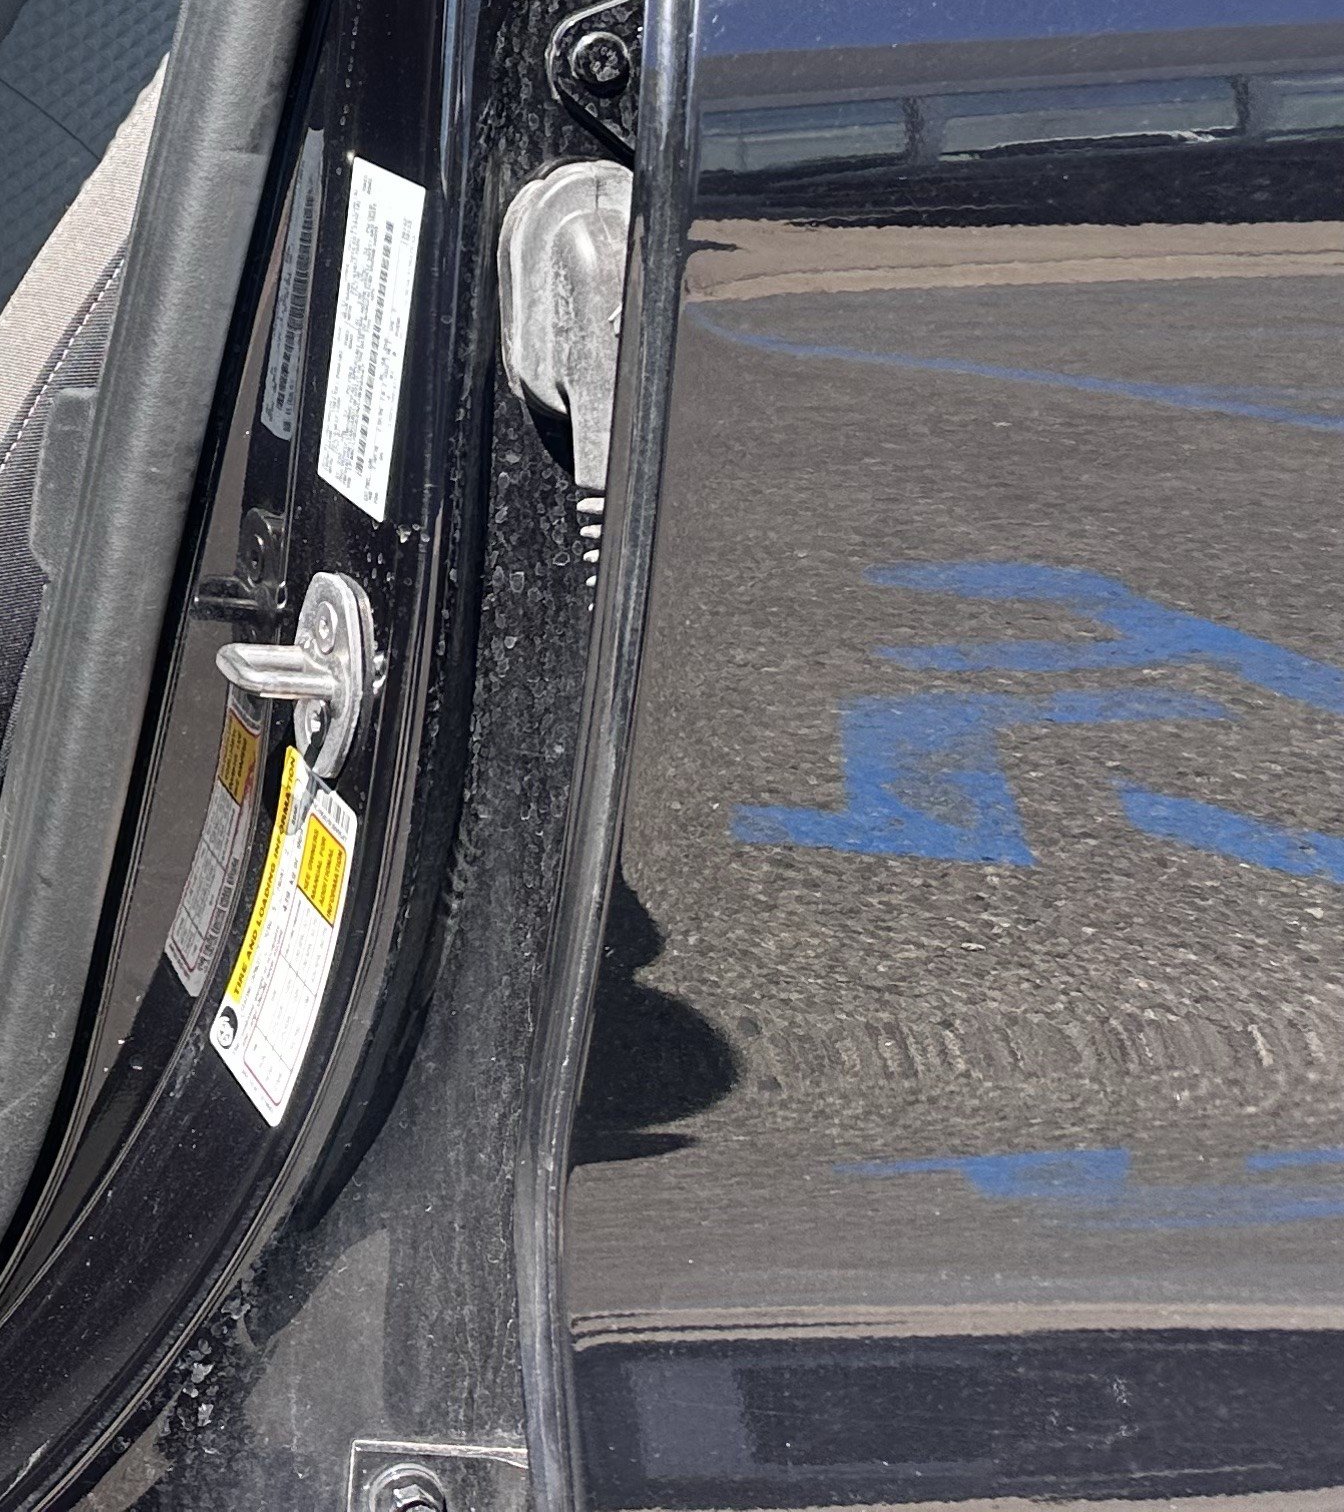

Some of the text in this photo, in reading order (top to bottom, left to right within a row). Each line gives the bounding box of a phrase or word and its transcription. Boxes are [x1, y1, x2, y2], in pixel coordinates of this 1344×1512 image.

[233, 960, 247, 997] TIRE
[245, 927, 258, 961] AND
[256, 861, 276, 926] LOADING
